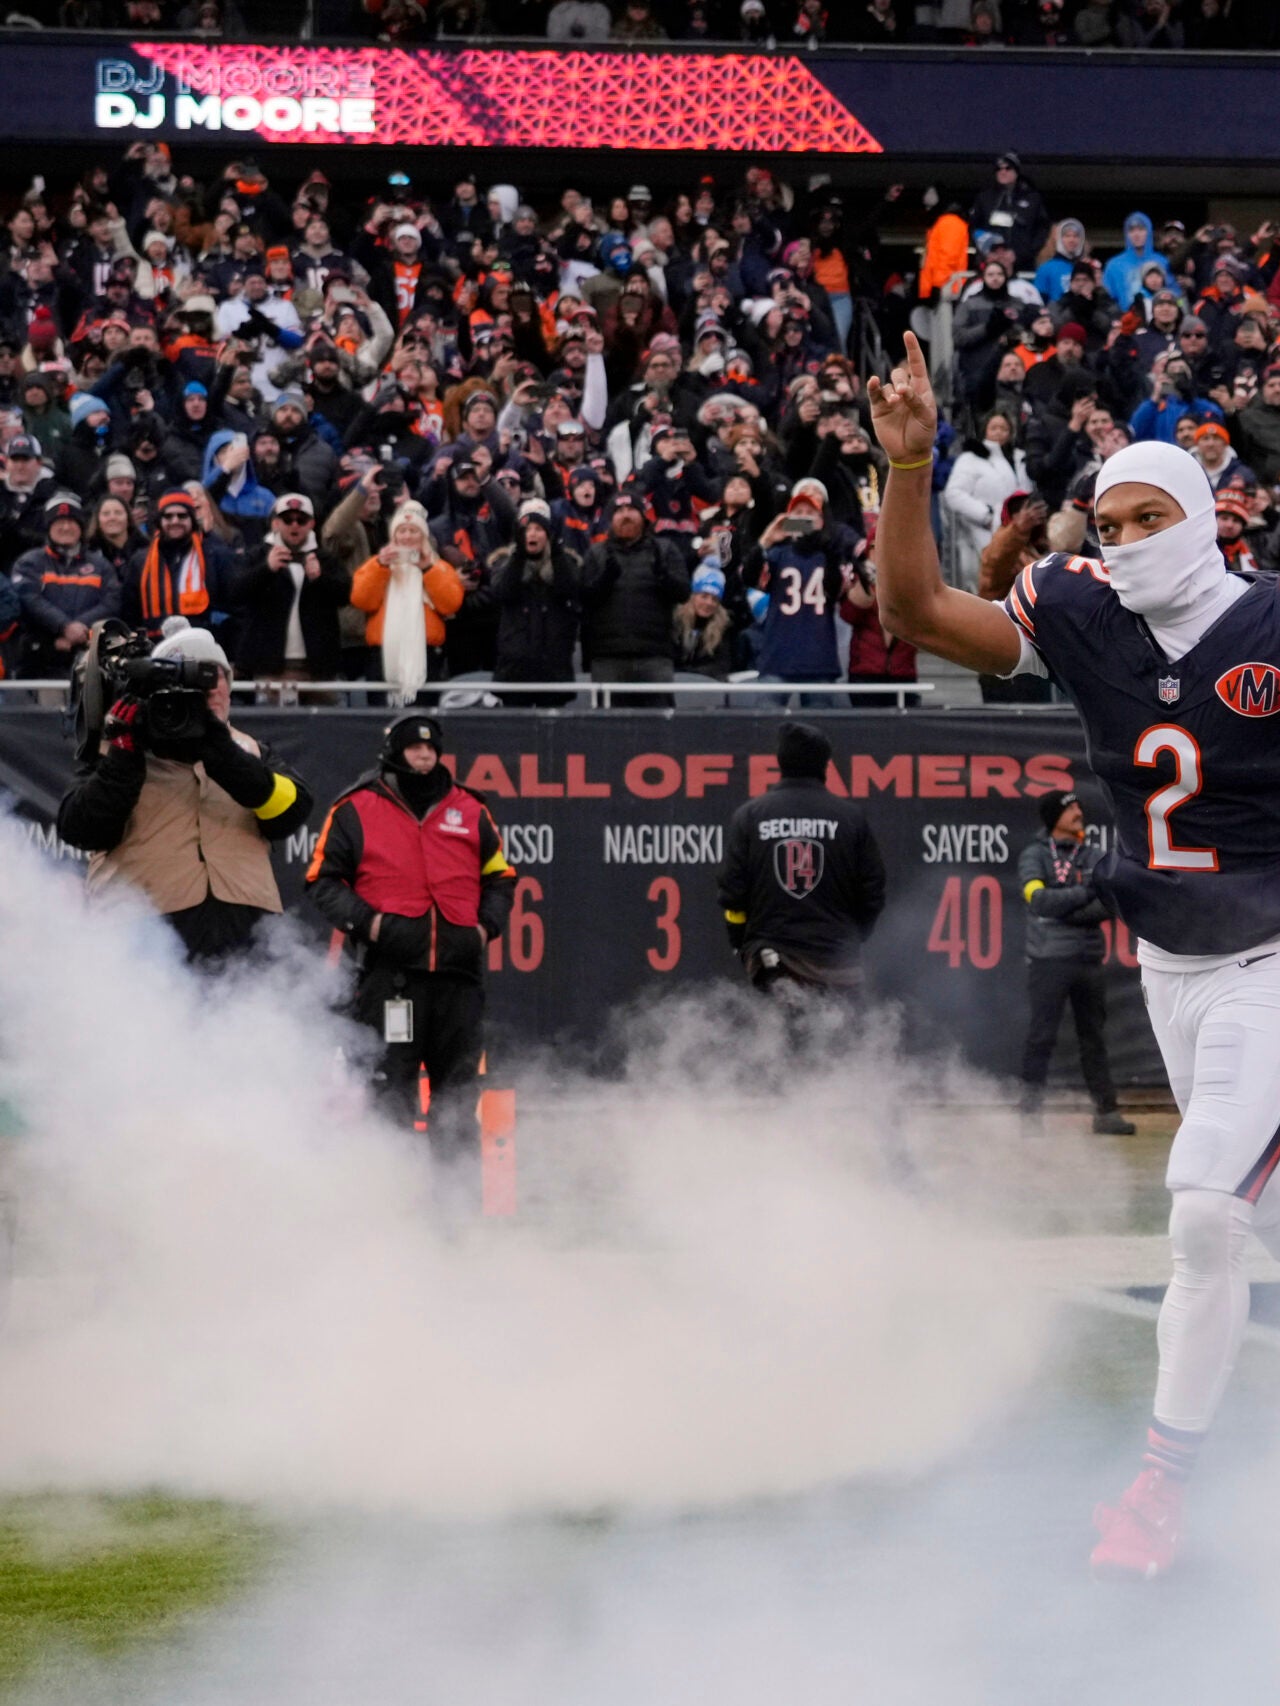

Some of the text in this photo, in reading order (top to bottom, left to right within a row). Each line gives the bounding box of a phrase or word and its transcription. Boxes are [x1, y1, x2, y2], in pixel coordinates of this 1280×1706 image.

[97, 60, 375, 97] DJ MOORE
[95, 93, 376, 132] DJ MOORE
[779, 567, 826, 615] 34
[1161, 688, 1177, 698] NFL
[624, 753, 733, 799] OF
[1134, 723, 1220, 872] 2
[604, 824, 723, 864] NAGURSKI
[758, 817, 839, 840] SECURITY
[922, 824, 1009, 863] SAYERS
[646, 876, 682, 971] 3
[927, 875, 1002, 969] 40
